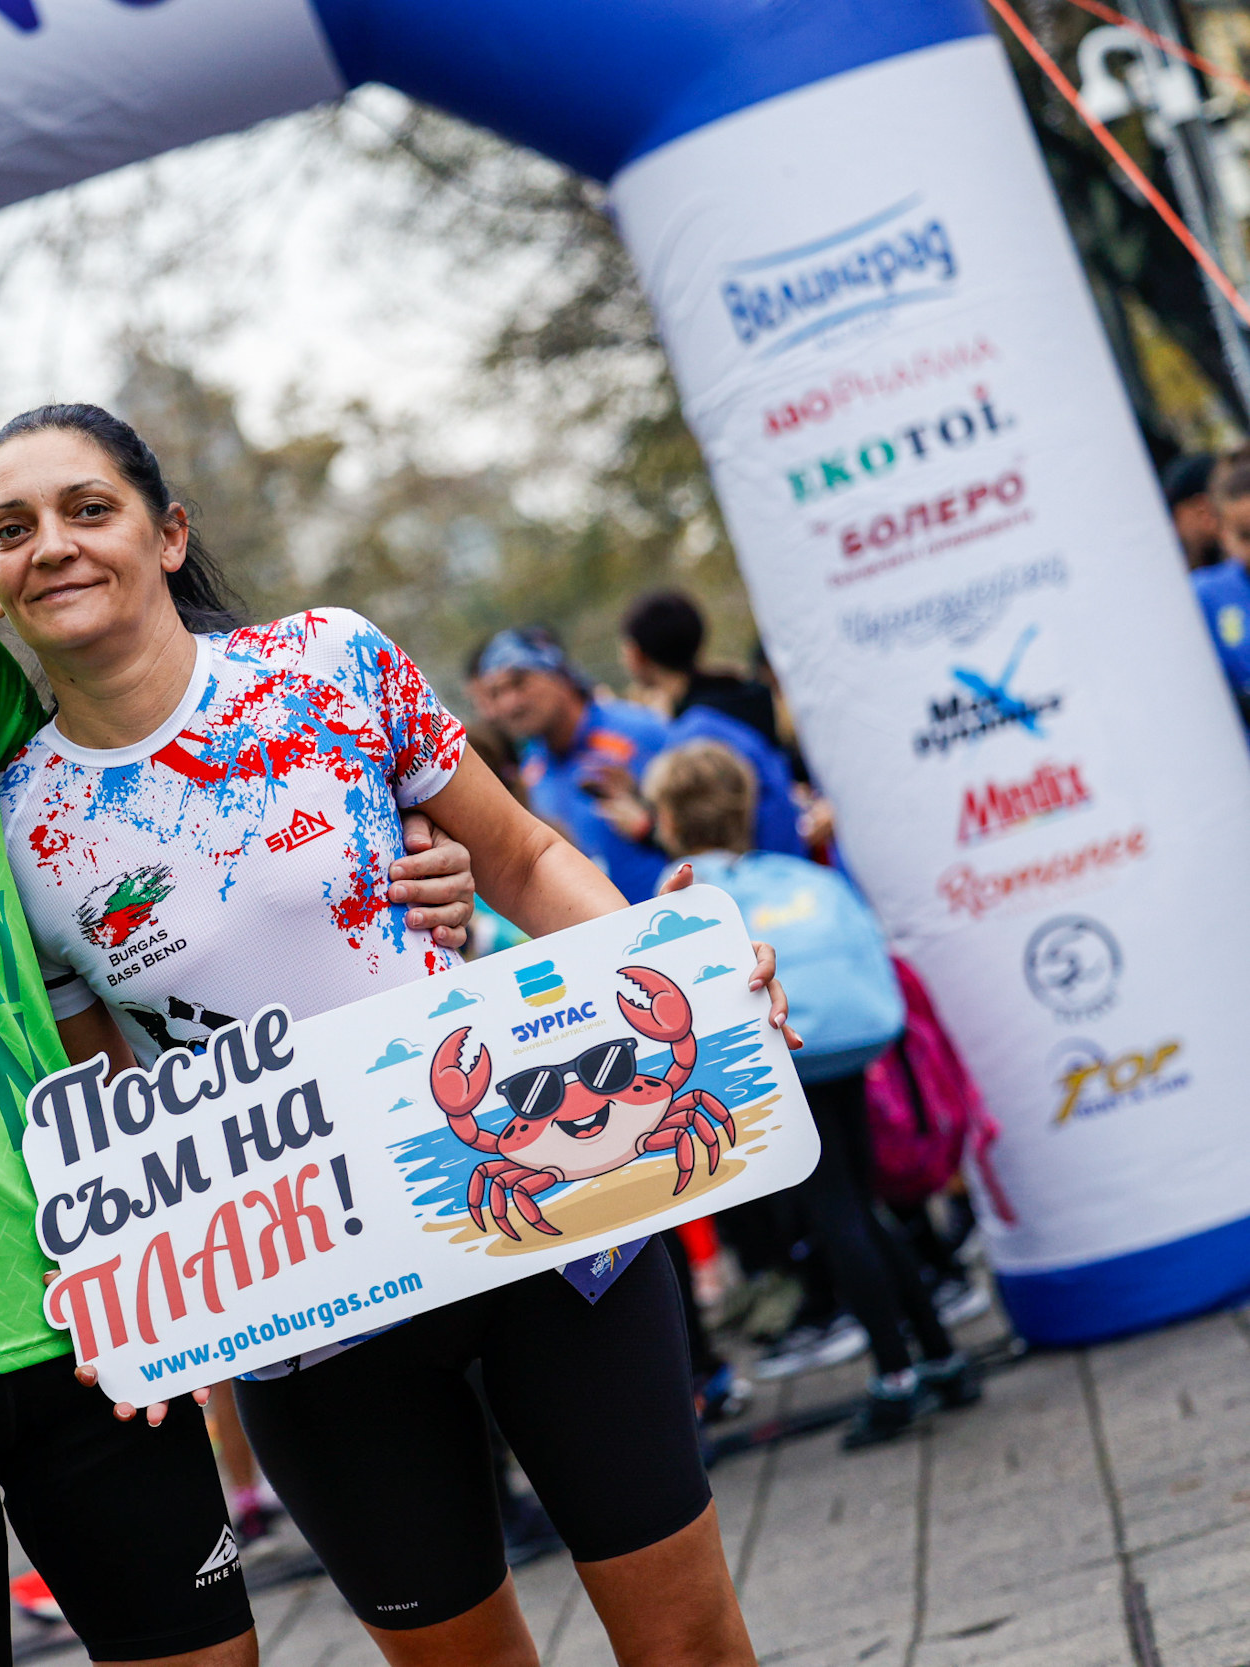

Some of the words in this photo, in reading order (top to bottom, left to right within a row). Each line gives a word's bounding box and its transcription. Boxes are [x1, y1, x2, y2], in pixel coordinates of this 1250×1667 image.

[106, 963, 141, 988] BASS
[141, 938, 187, 968] BEND
[108, 928, 168, 968] BURGAS
[513, 1037, 553, 1056] ВЪЛНУВАЩ
[553, 1034, 560, 1042] И
[560, 1019, 607, 1040] АРТИСТИЧЕН
[32, 1009, 294, 1167] После
[41, 1135, 212, 1256] съм
[221, 1079, 334, 1178] на
[139, 1272, 423, 1382] www.gotoburgas.com
[195, 1567, 229, 1589] NIKE
[376, 1600, 419, 1611] KIPRUN
